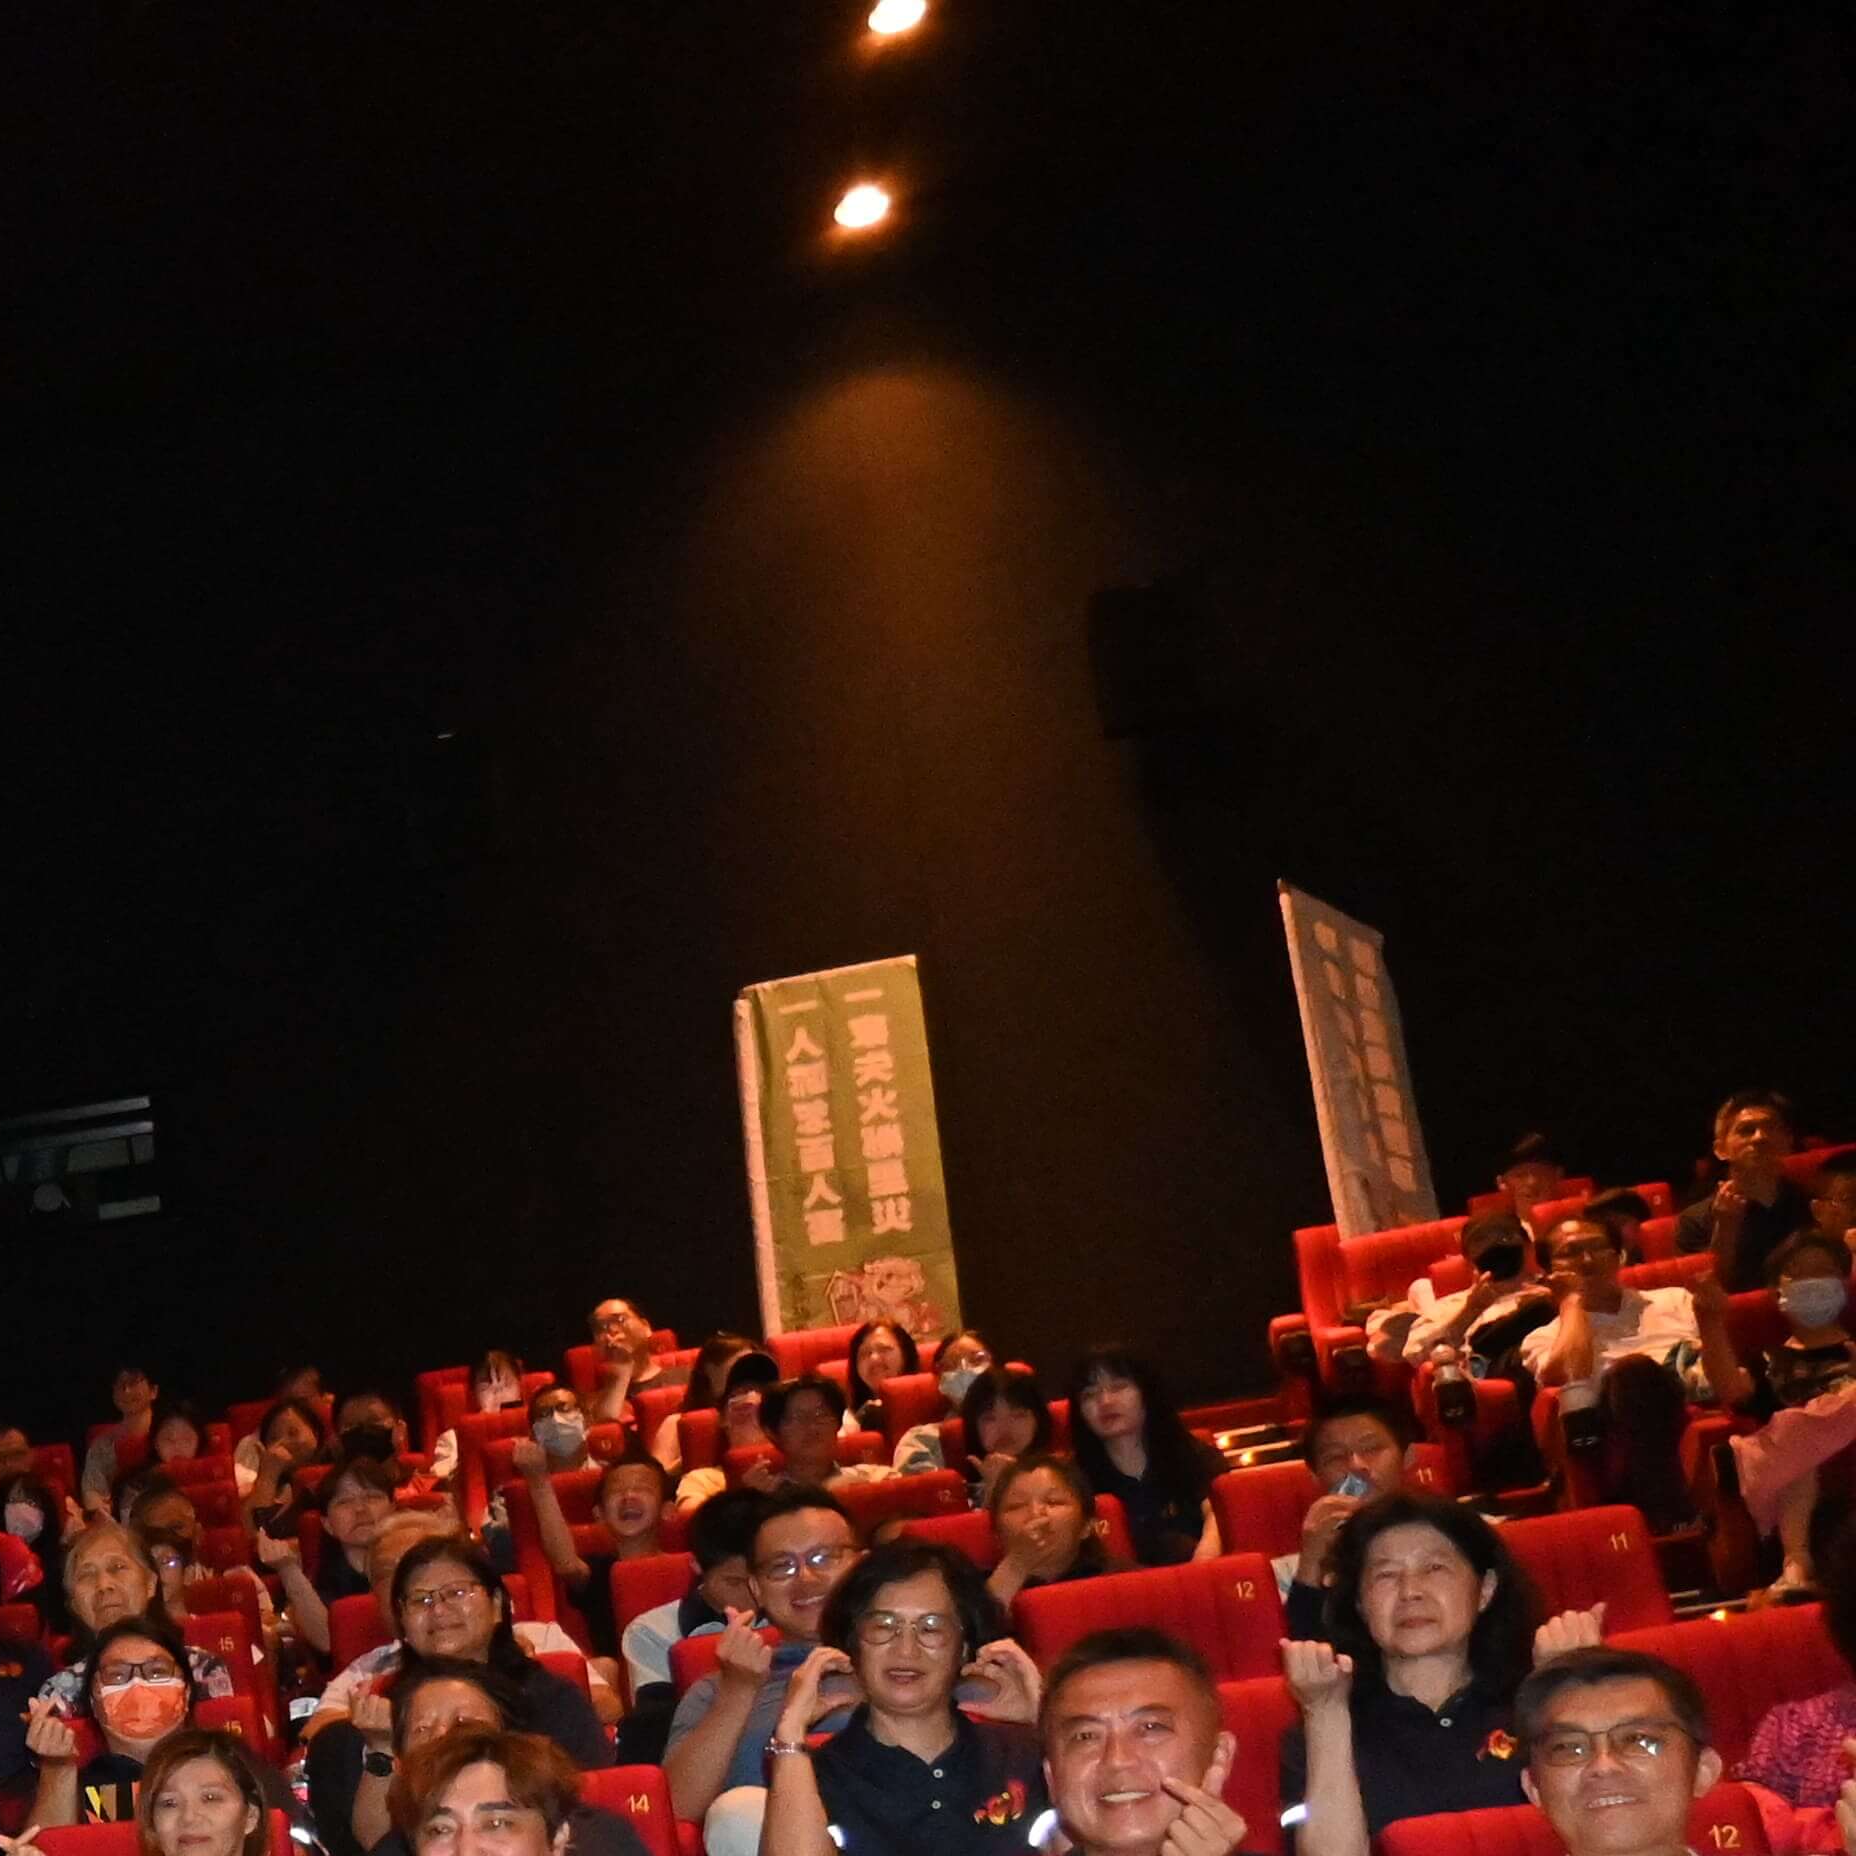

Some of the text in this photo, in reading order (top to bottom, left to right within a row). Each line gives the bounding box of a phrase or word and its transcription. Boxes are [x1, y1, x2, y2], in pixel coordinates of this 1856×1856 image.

[1416, 1466, 1433, 1484] 11
[1609, 1531, 1629, 1552] 11
[1235, 1580, 1255, 1600] 12
[626, 1793, 651, 1815] 14
[1708, 1823, 1741, 1849] 12
